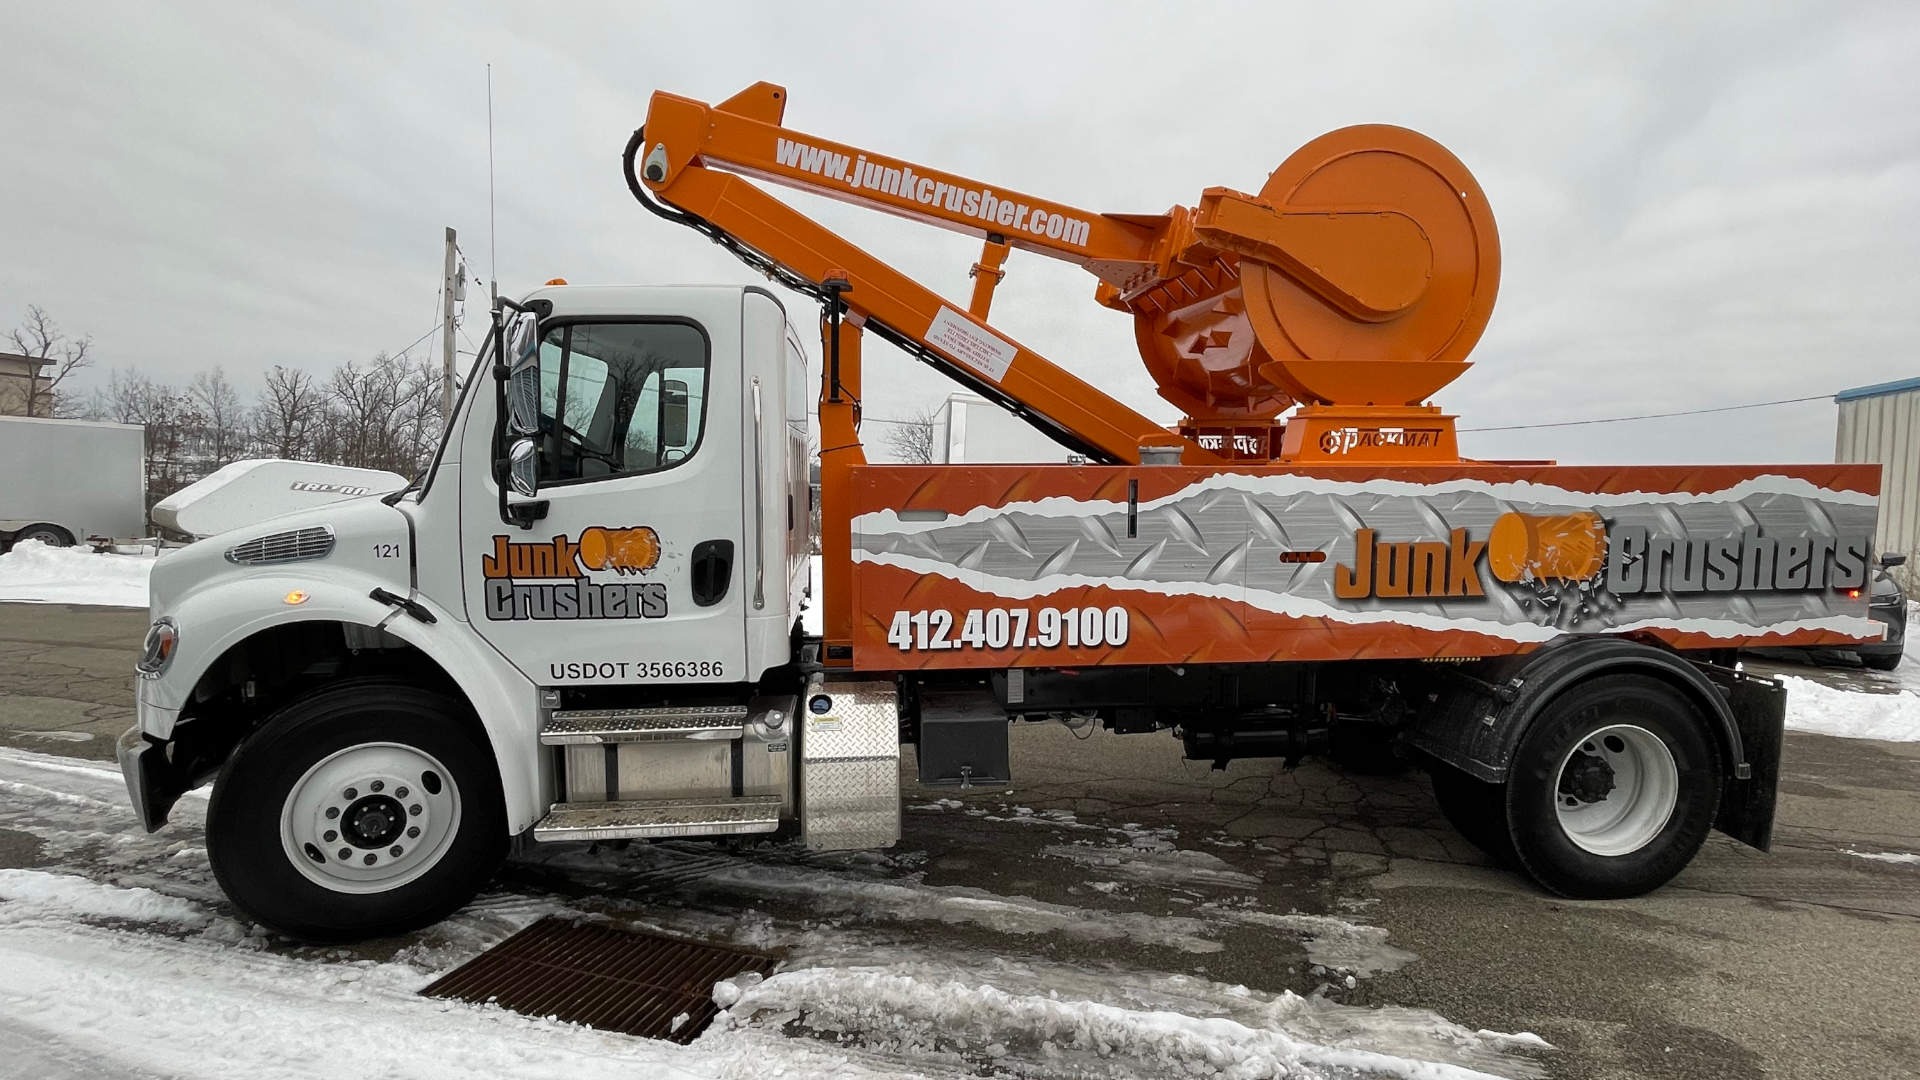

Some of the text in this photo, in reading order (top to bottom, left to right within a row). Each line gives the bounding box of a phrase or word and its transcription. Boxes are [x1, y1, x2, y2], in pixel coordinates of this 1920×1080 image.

[776, 137, 1091, 248] www.junkcrusher.com
[373, 544, 400, 558] 121
[482, 534, 583, 578] Junk
[1335, 523, 1869, 600] Junk Crushers
[484, 576, 668, 620] Crushers
[887, 606, 1129, 650] 412.407.9100
[550, 661, 723, 679] USDOT 3566386
